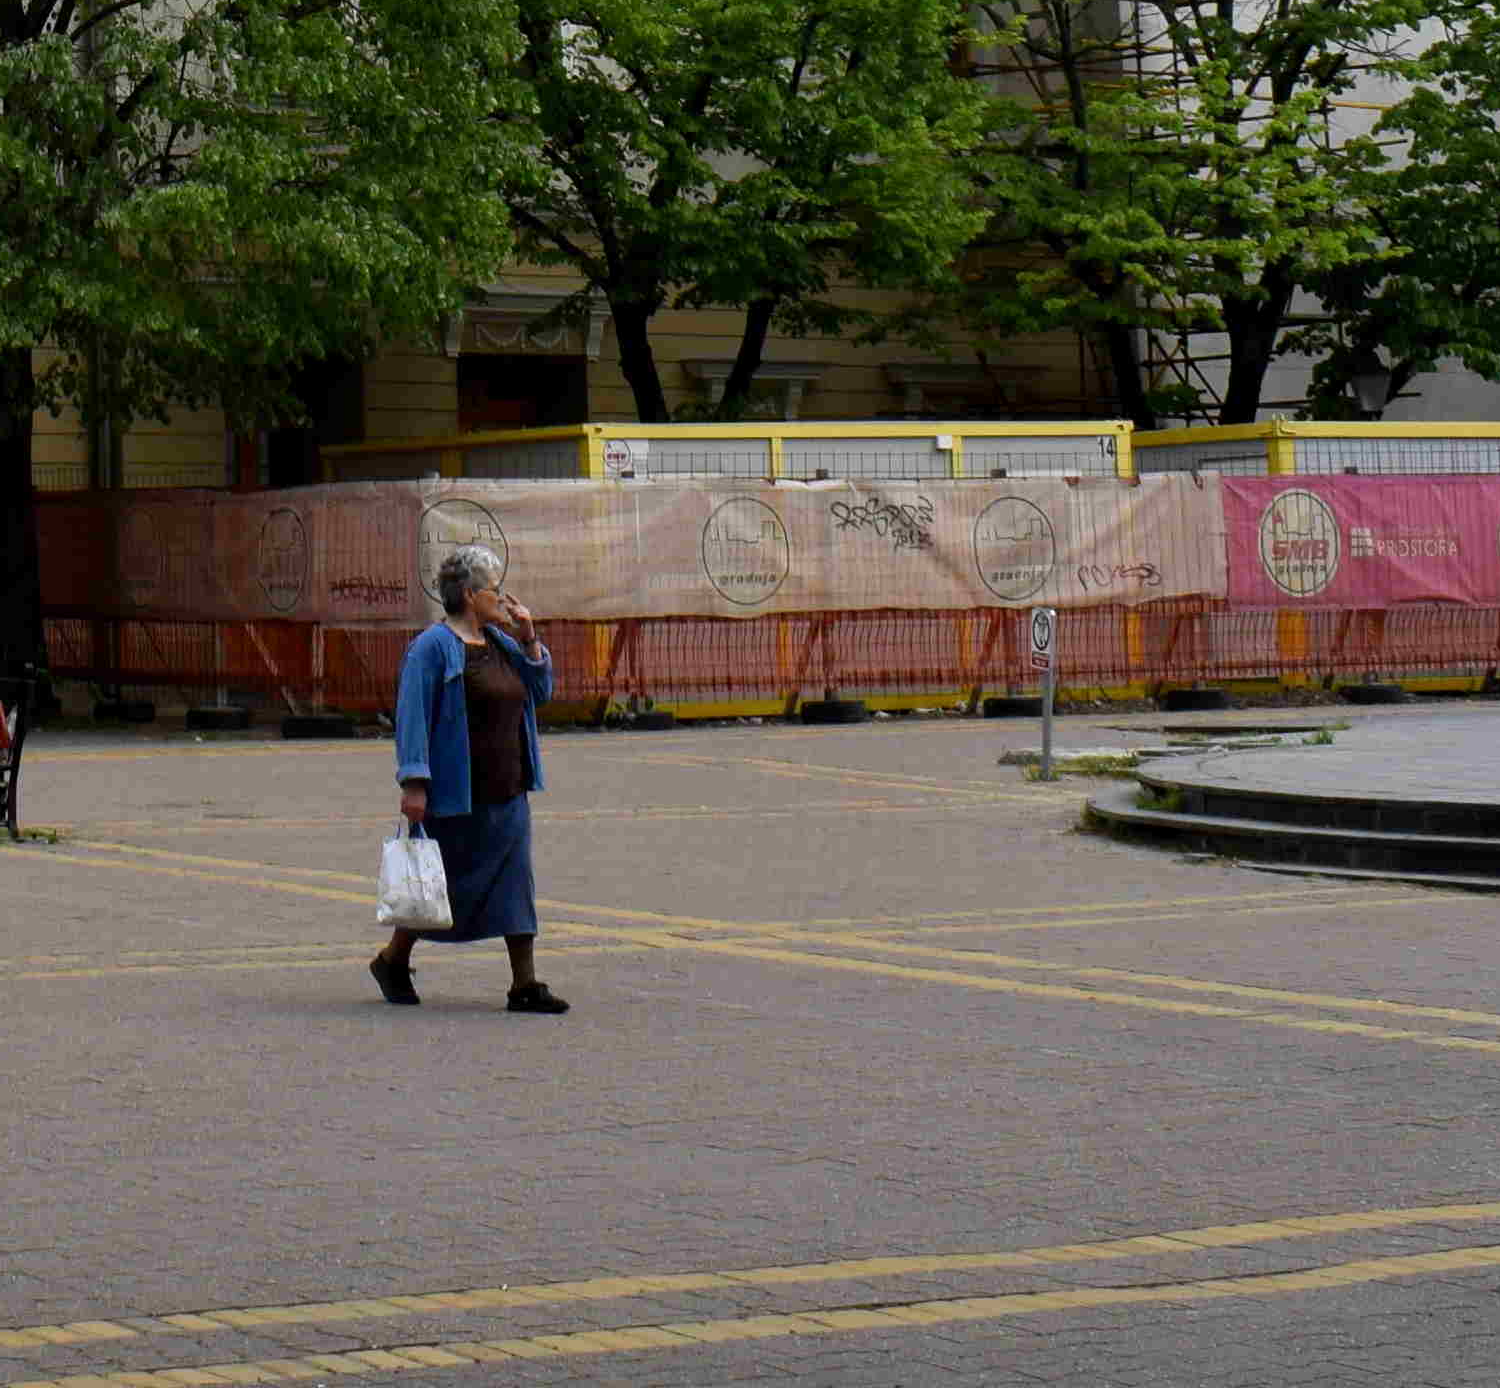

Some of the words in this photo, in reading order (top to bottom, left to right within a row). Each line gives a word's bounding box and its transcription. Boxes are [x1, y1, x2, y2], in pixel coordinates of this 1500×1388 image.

[1097, 436, 1114, 458] 14
[1271, 540, 1329, 560] SMB
[1376, 539, 1458, 557] PROSTORA
